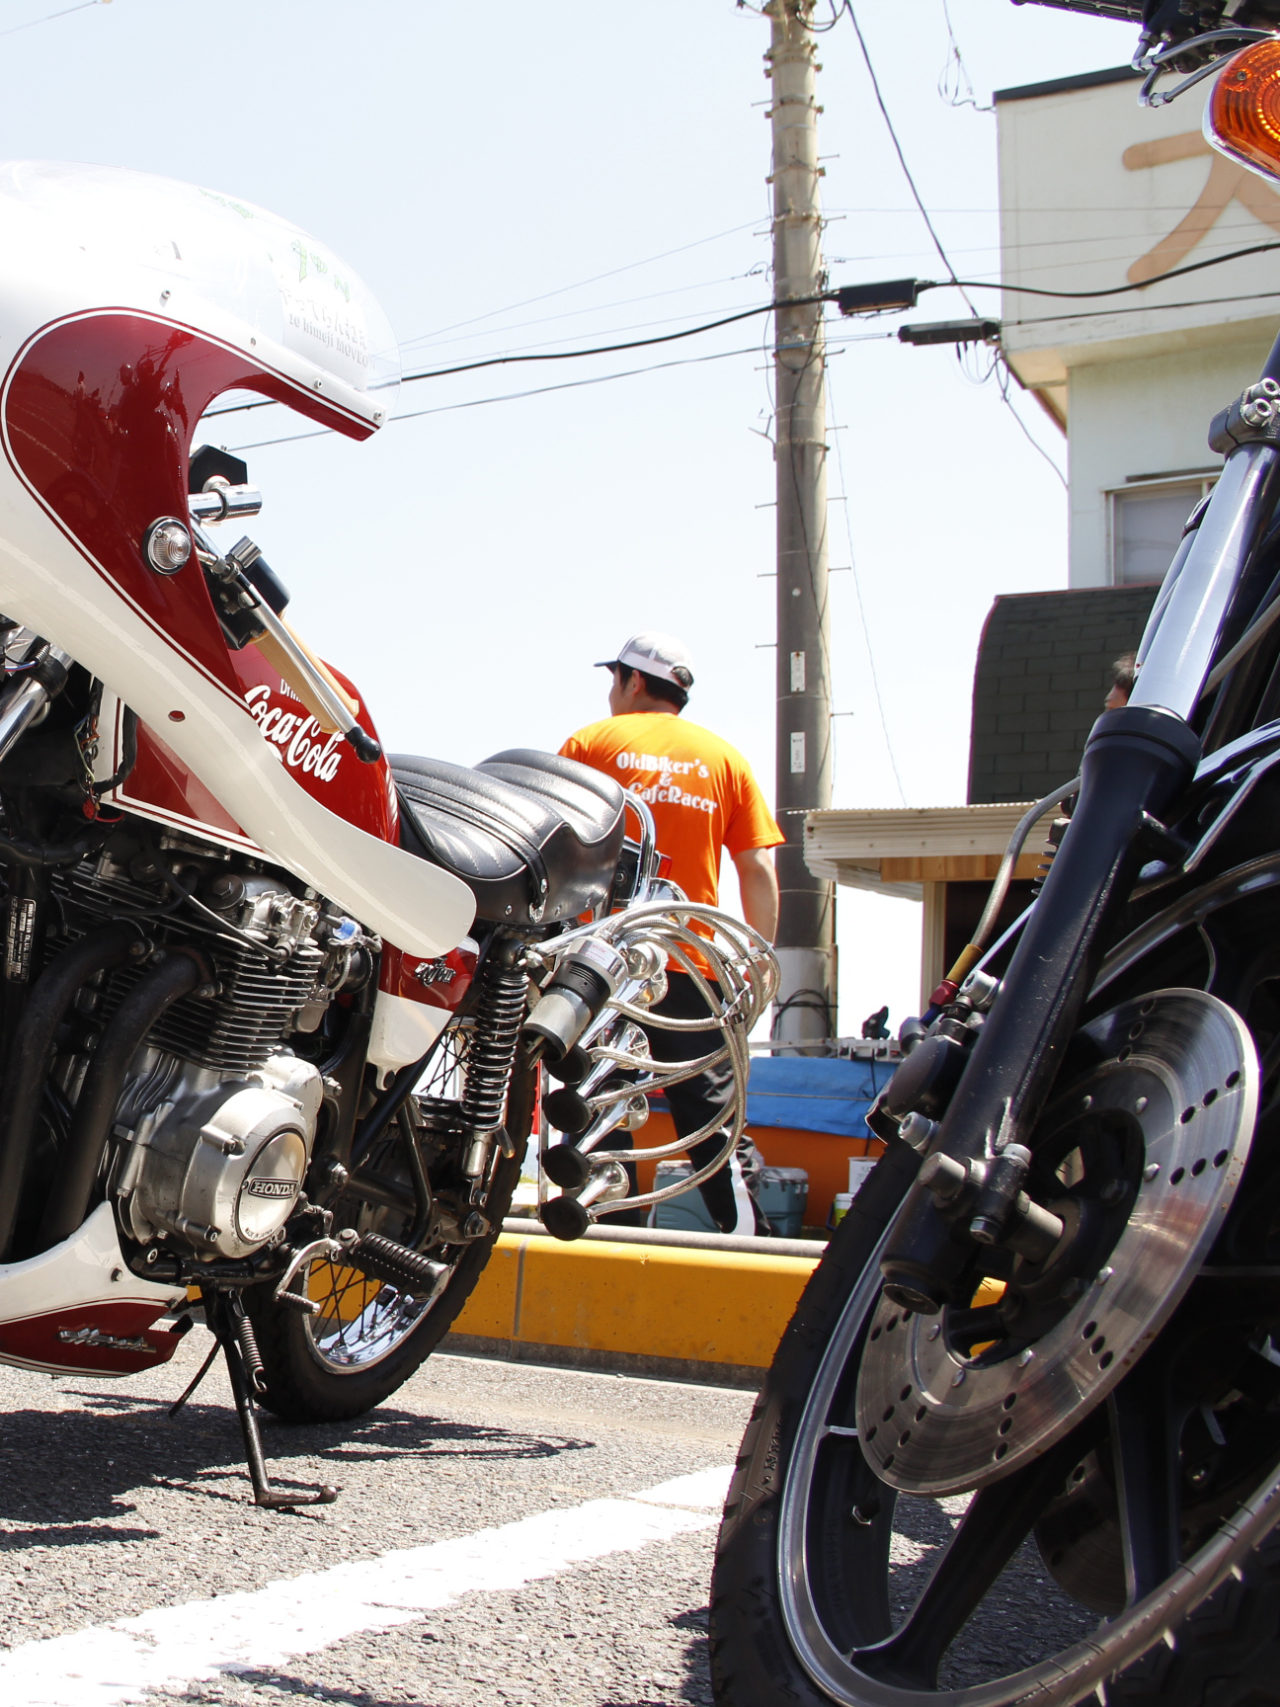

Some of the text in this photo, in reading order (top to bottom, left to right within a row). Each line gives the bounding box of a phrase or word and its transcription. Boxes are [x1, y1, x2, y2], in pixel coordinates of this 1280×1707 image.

[244, 685, 345, 782] Coca-Cola
[659, 772, 672, 787] &
[252, 1181, 294, 1195] HONDA
